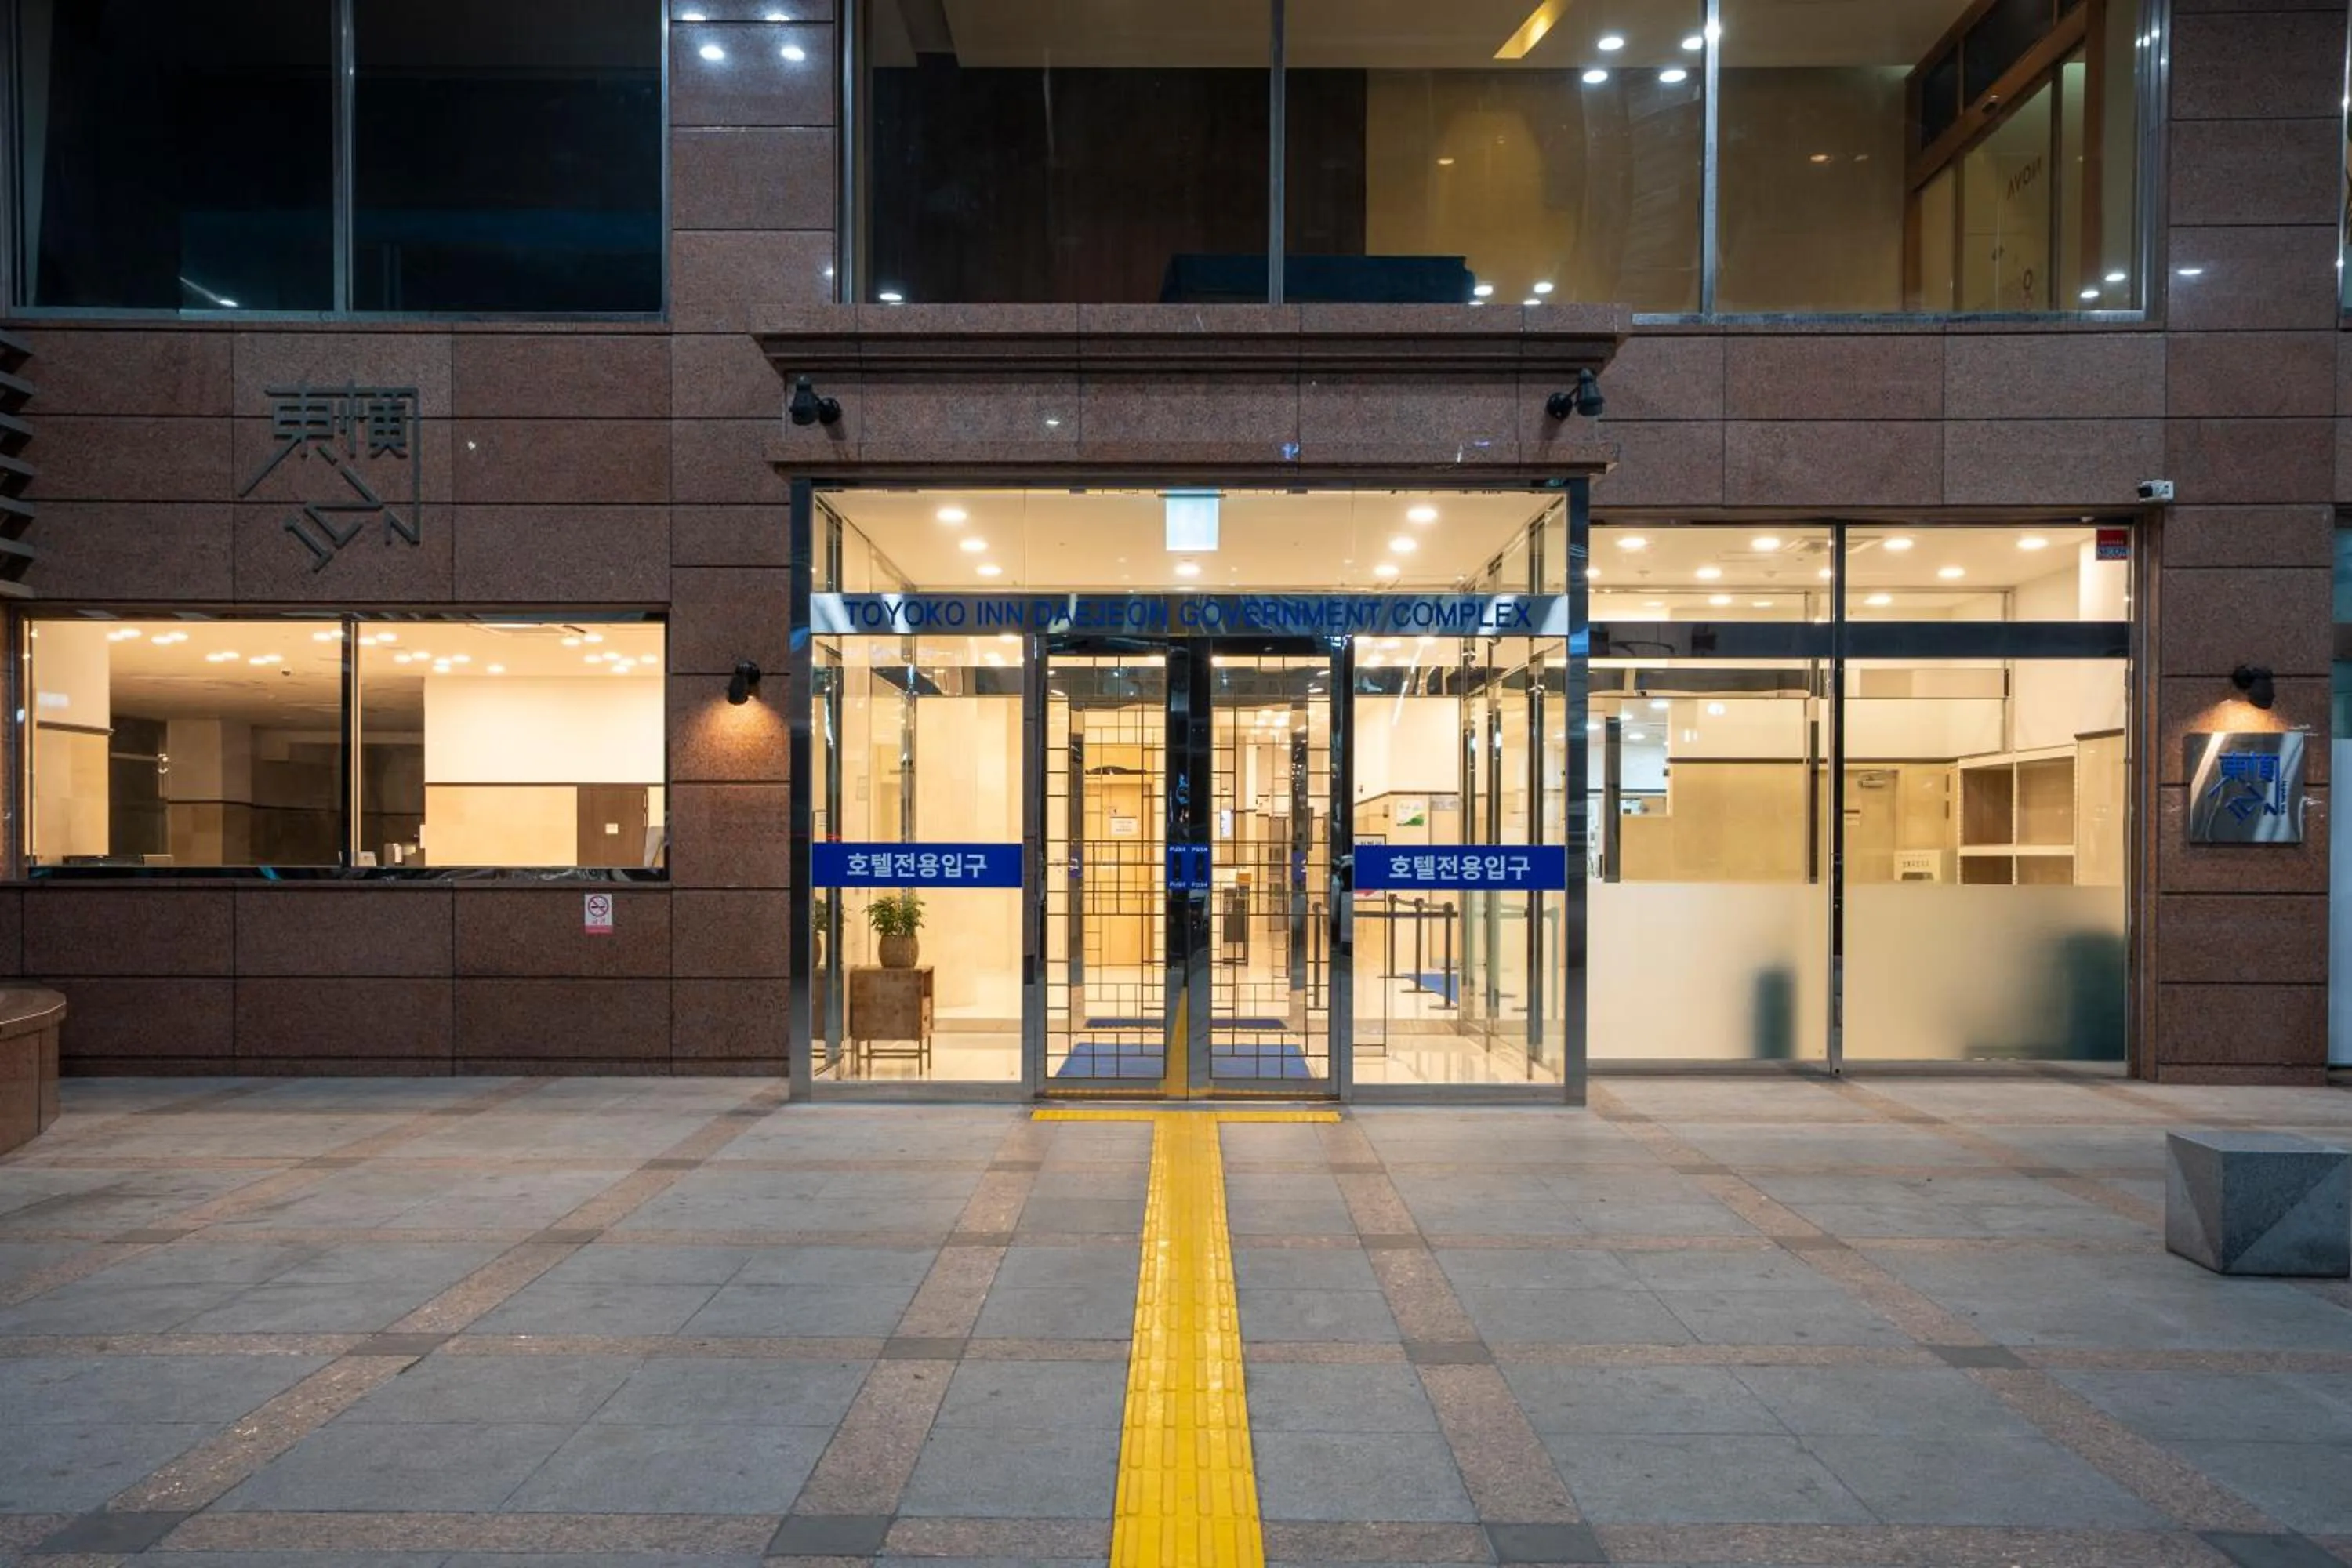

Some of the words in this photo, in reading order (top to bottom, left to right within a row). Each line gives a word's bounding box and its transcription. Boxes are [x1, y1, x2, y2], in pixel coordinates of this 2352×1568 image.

[844, 601, 966, 626] TOYOKO
[978, 601, 1025, 626] INN
[1033, 601, 1167, 626] DAEJEON
[1178, 601, 1381, 627] GOVERNMENT
[1392, 601, 1532, 628] COMPLEX
[846, 851, 988, 878] 호텔전용입구
[1388, 854, 1531, 880] 호텔전용입구
